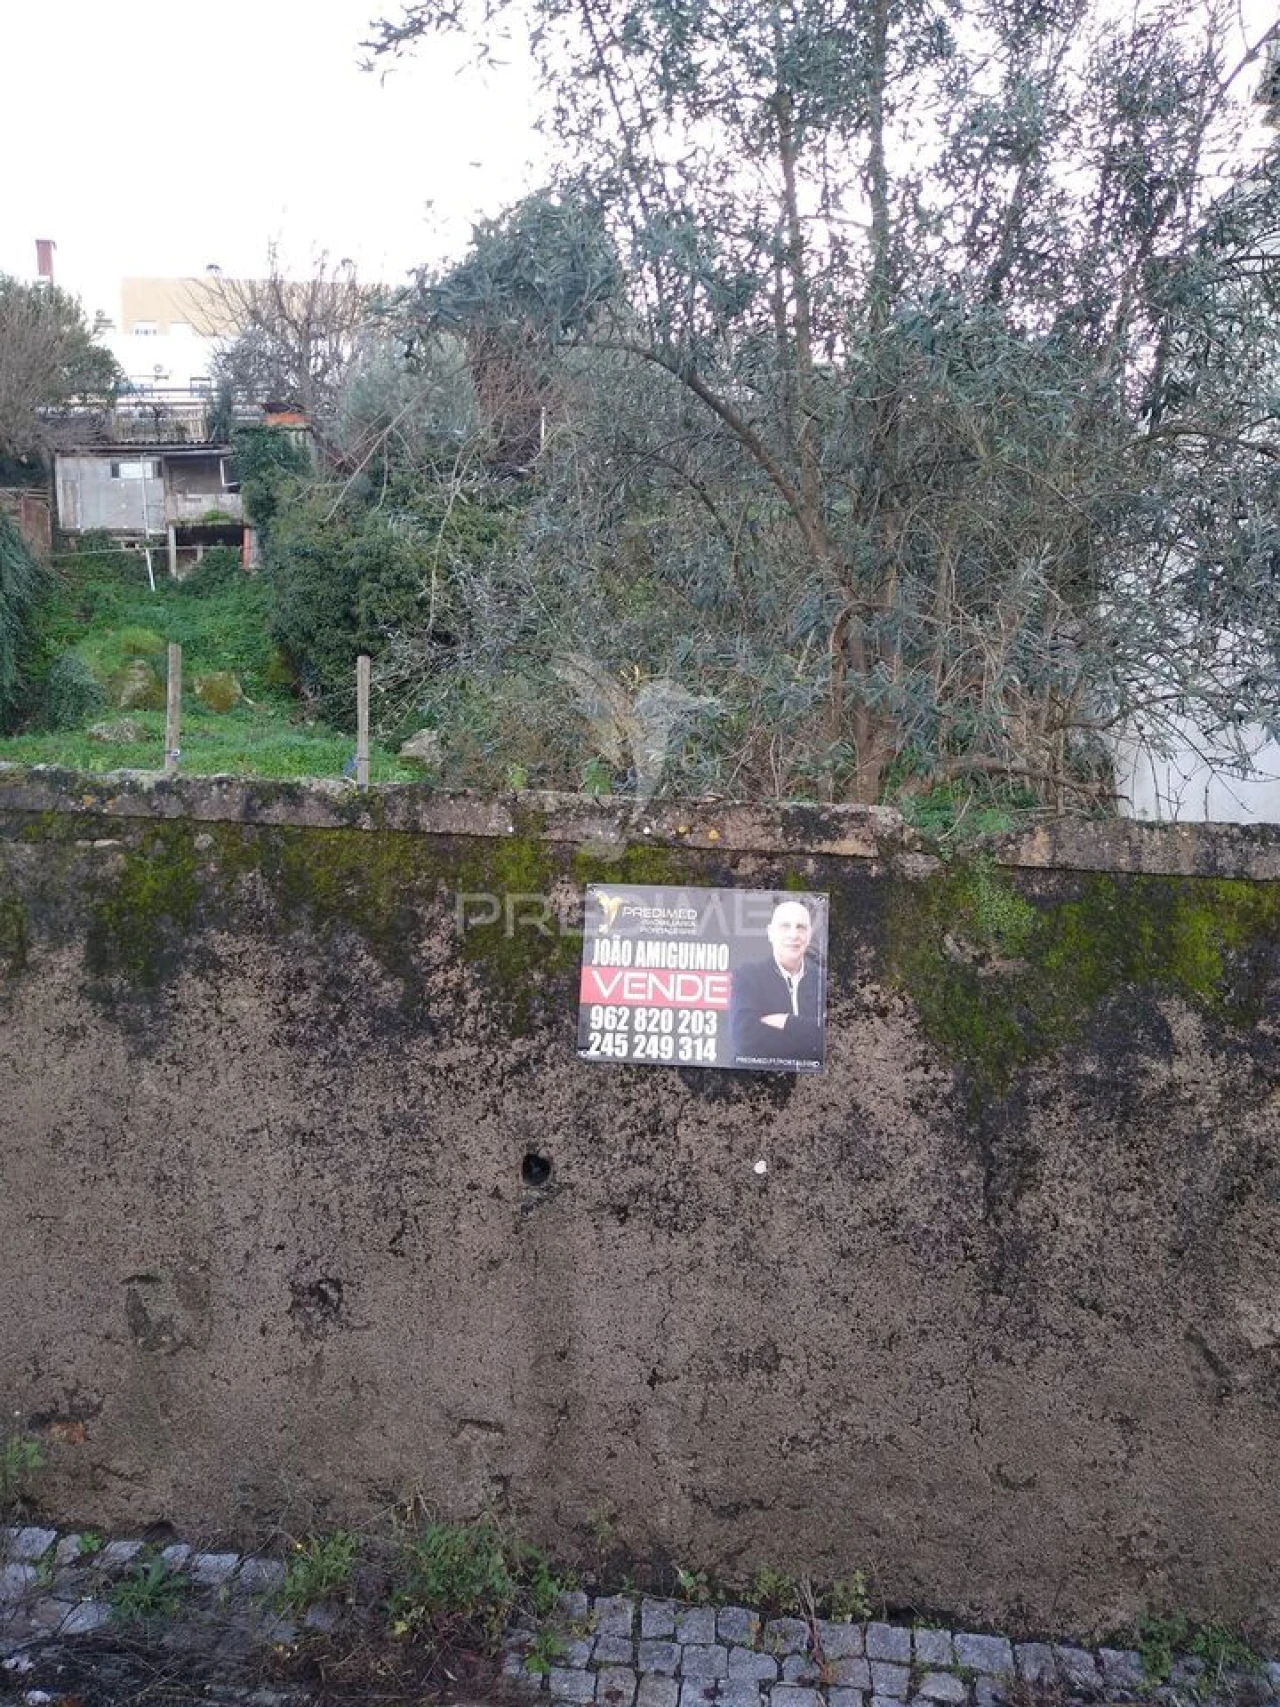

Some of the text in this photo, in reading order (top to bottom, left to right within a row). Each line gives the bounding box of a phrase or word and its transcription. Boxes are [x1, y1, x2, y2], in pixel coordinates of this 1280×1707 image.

[621, 906, 698, 920] PREDIMED
[591, 934, 730, 971] JOÃO AMIGUINHO
[591, 970, 729, 1004] VENDE
[590, 1004, 718, 1036] 962 820 203
[588, 1032, 717, 1062] 245 249 314
